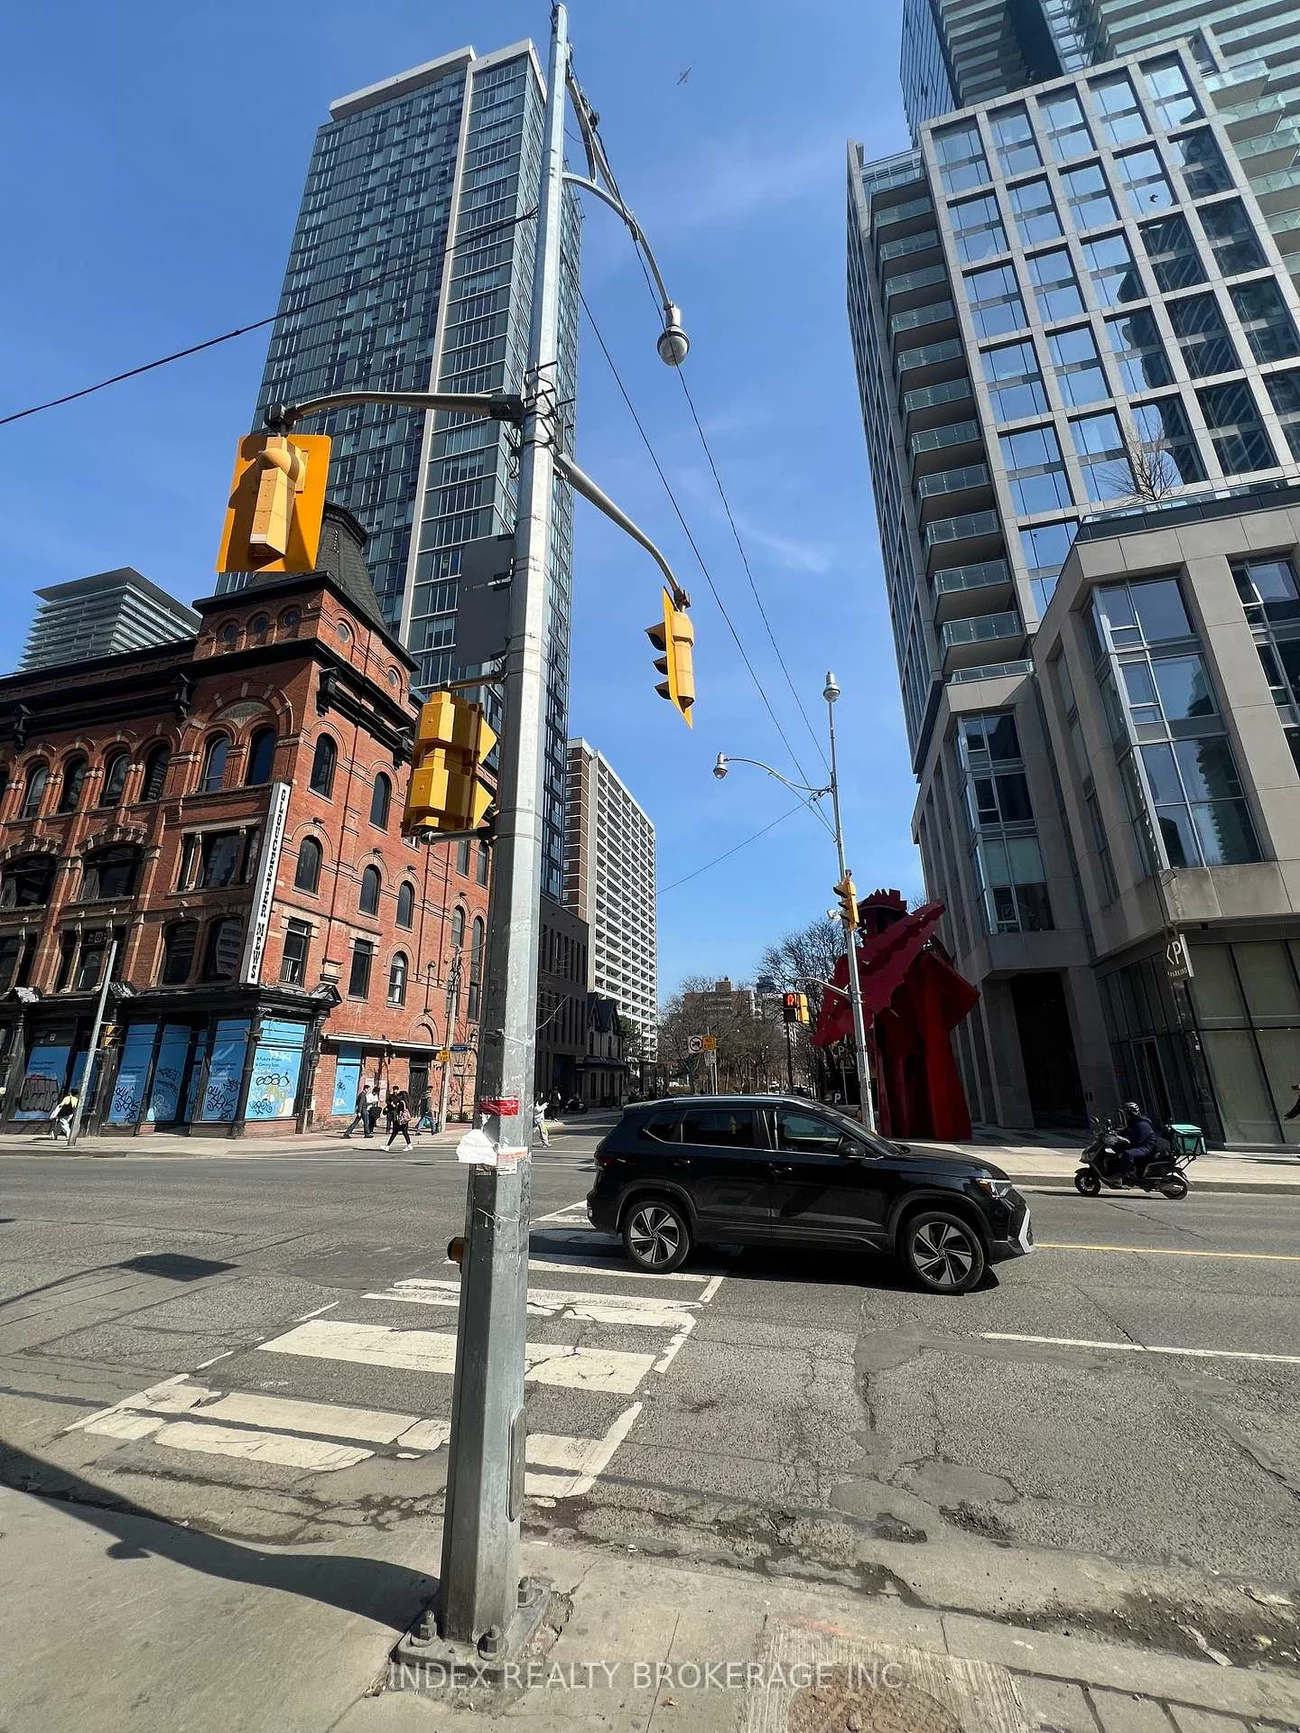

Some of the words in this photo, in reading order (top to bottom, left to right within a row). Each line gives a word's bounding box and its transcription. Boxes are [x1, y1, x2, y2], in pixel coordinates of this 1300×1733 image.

[260, 789, 287, 918] GLOUCESTER
[250, 922, 265, 979] MEWS
[1172, 940, 1181, 964] P
